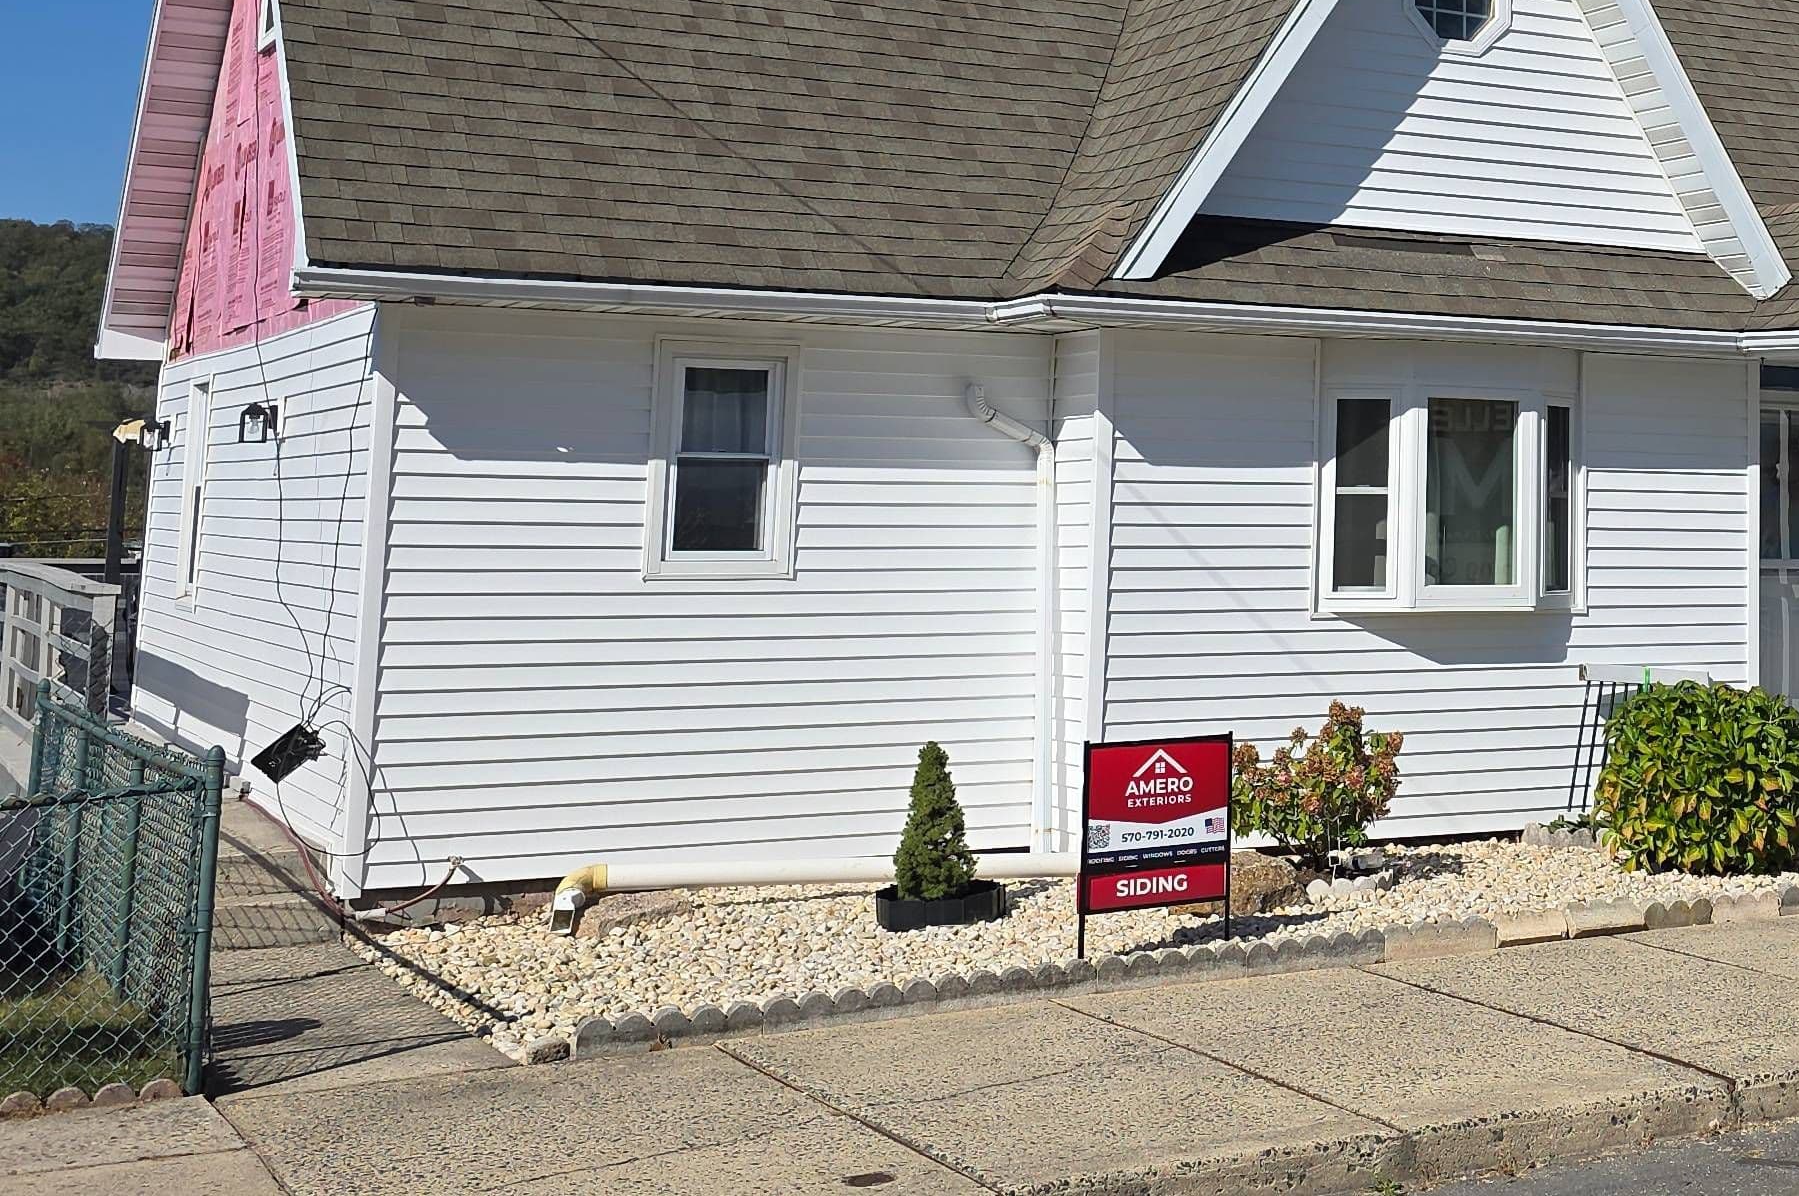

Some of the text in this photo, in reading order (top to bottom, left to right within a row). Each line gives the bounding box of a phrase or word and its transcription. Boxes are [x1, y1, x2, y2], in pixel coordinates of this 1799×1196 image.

[1125, 776, 1194, 797] AMERO
[1127, 794, 1192, 808] EXTERIORS
[1121, 826, 1195, 843] 570-791-2020
[1116, 873, 1188, 897] SIDING
